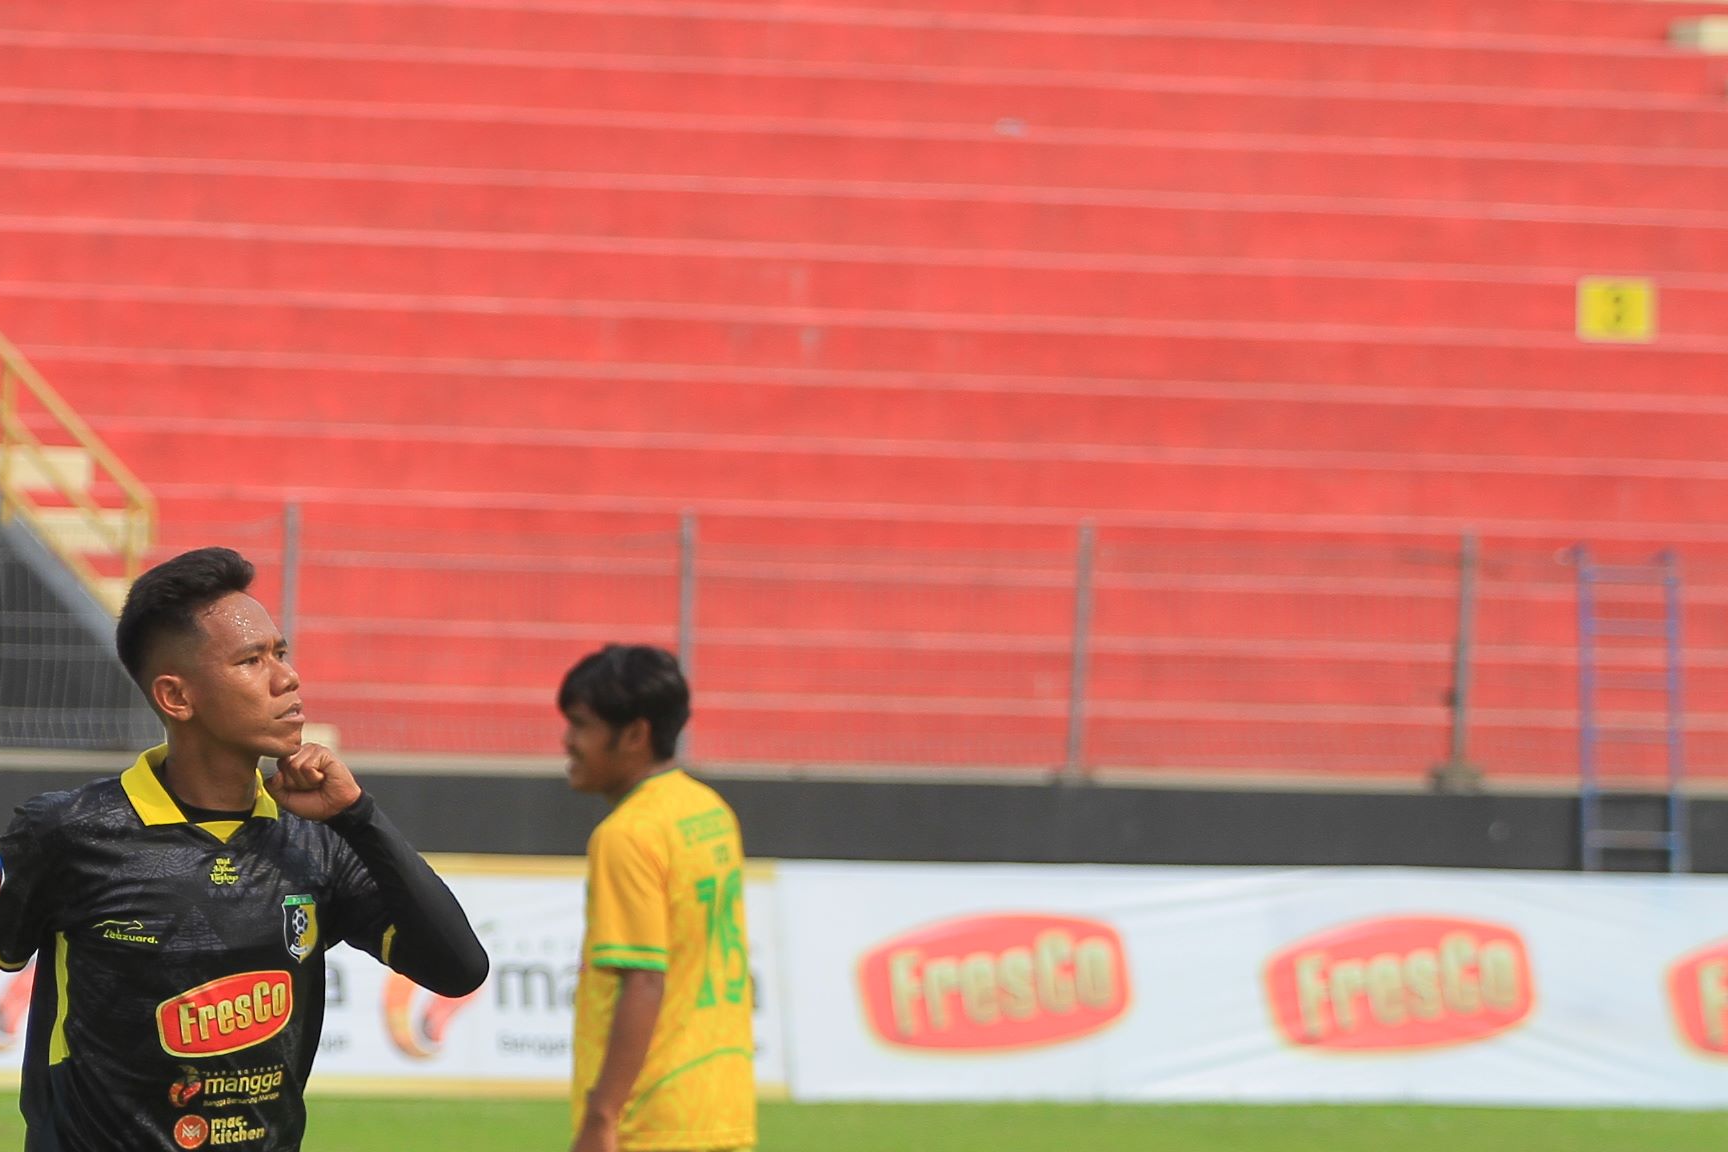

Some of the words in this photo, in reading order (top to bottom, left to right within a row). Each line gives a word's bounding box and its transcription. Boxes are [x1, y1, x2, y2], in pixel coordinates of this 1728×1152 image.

[178, 980, 287, 1045] FresCo
[889, 932, 1112, 1037] FresCo
[1295, 935, 1516, 1038] FresCo
[204, 1070, 283, 1095] mangga
[210, 1126, 265, 1145] kitchen
